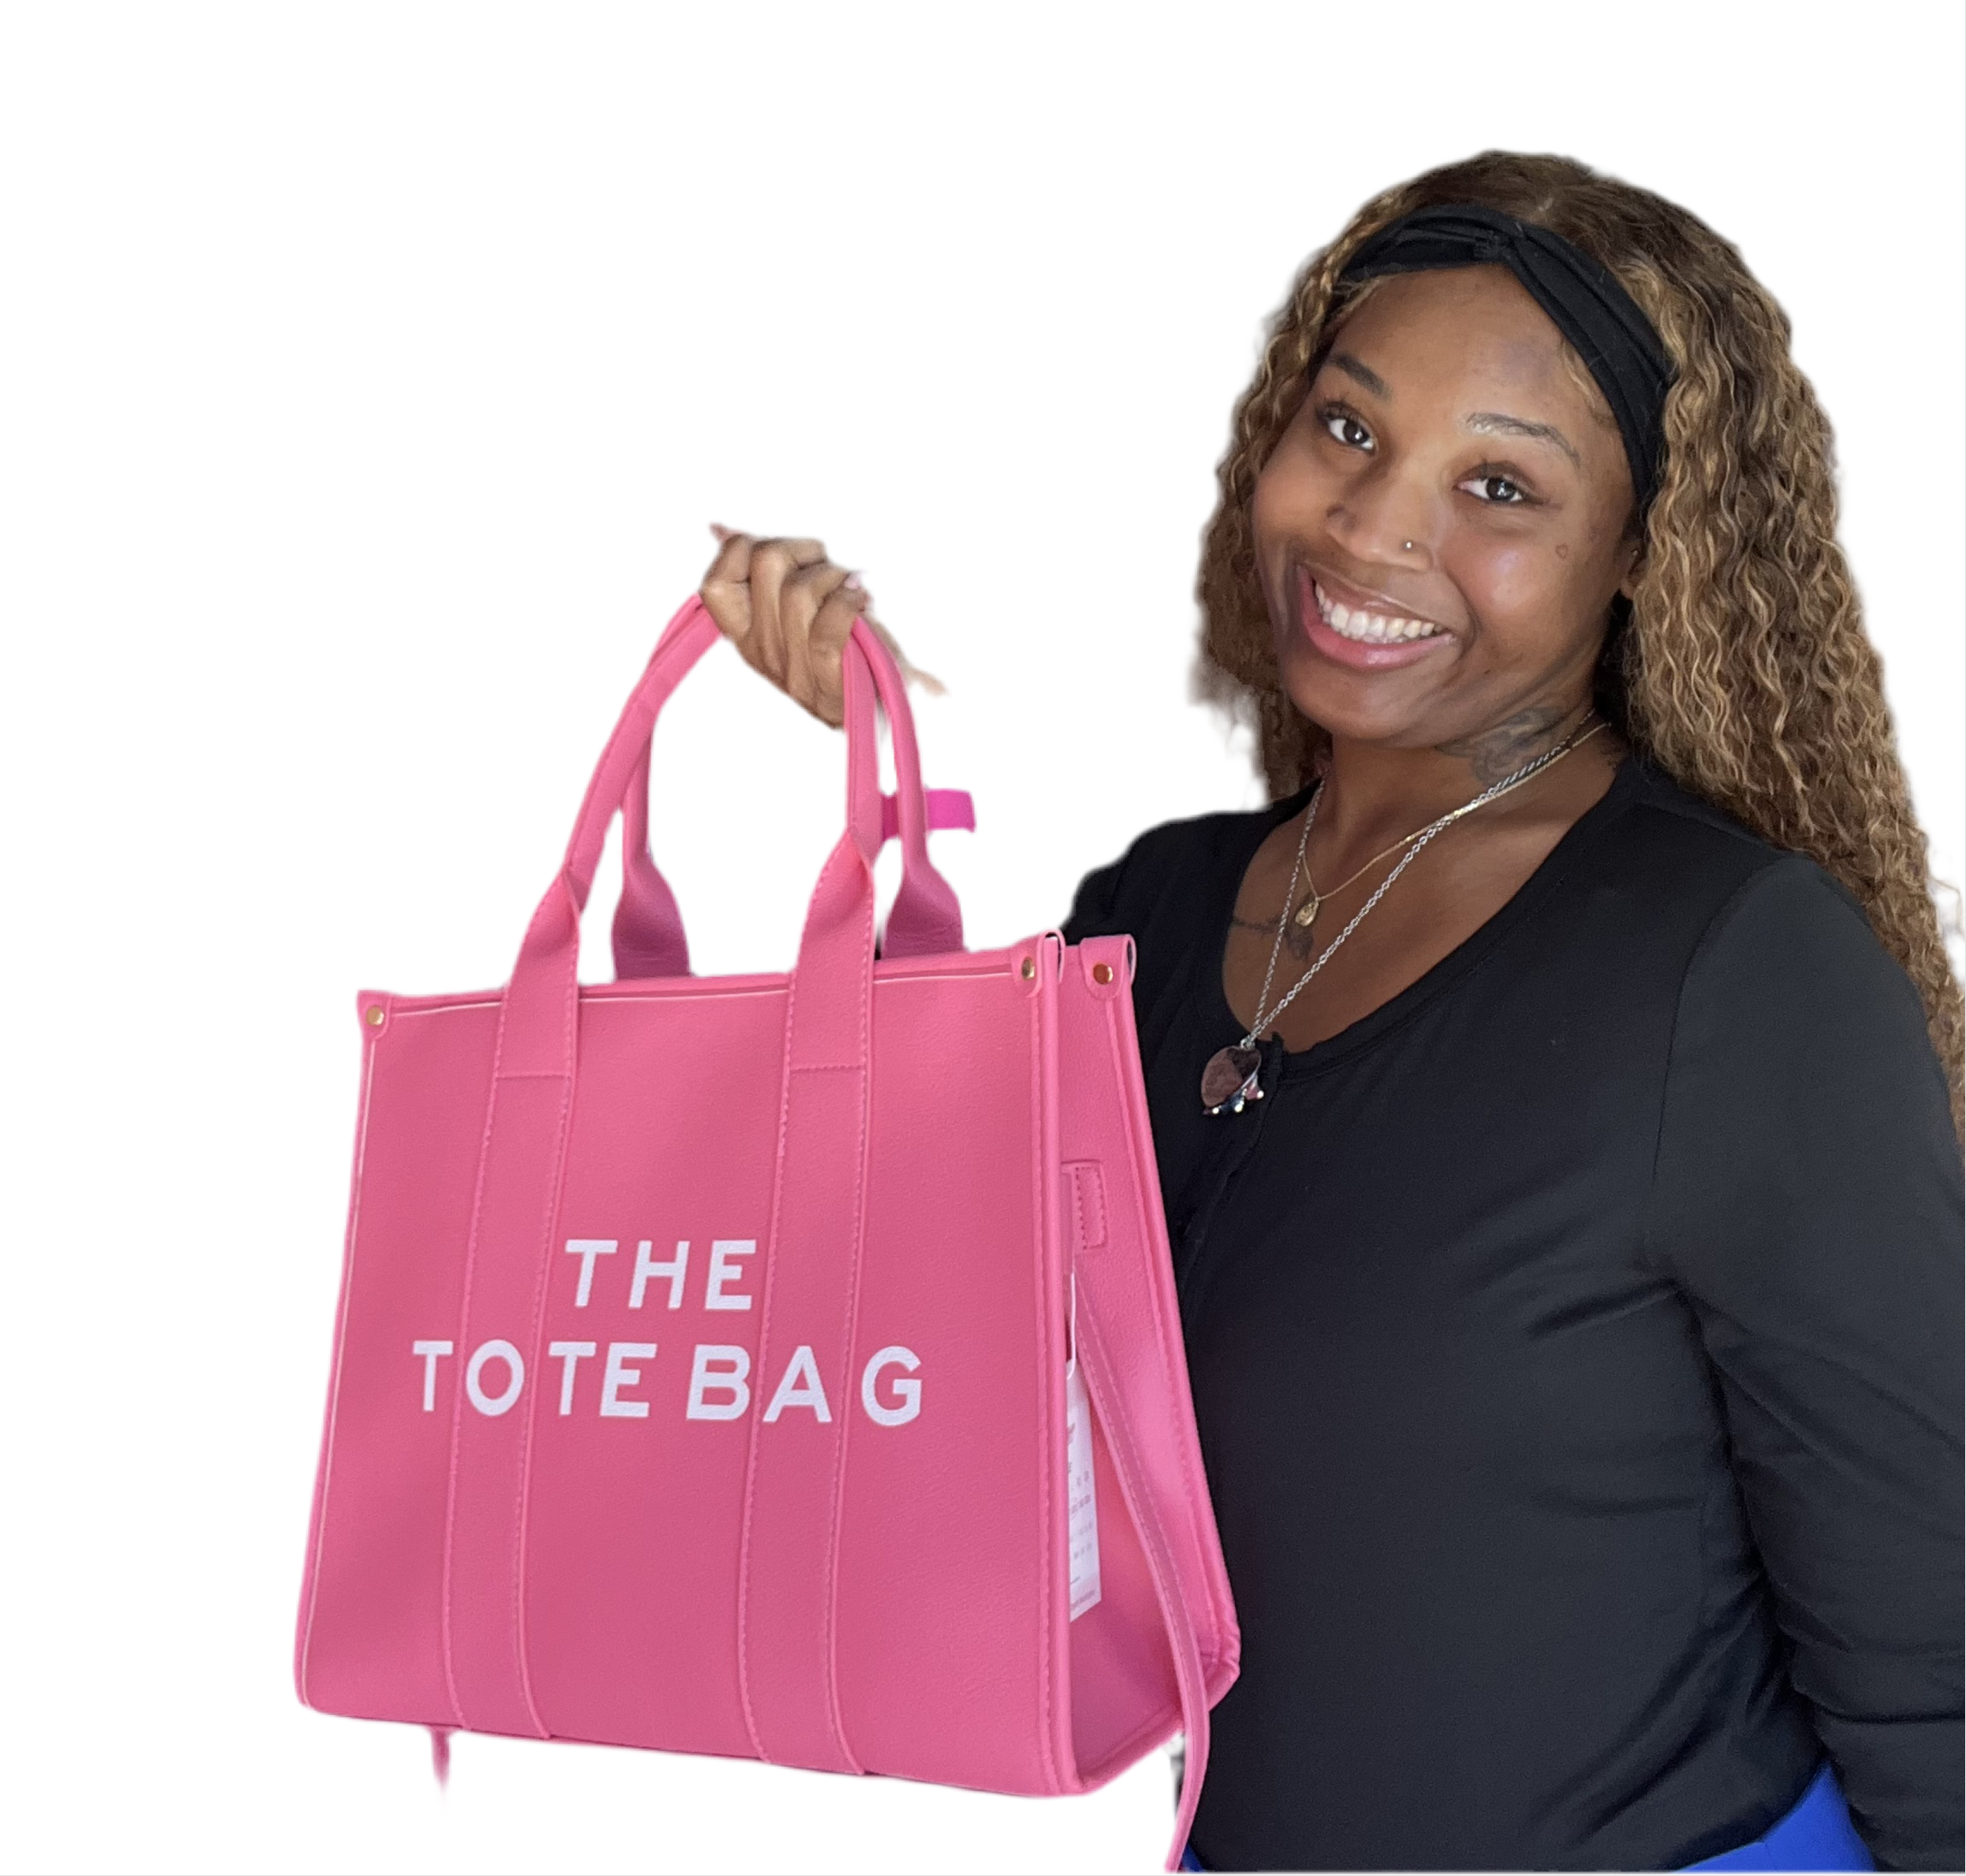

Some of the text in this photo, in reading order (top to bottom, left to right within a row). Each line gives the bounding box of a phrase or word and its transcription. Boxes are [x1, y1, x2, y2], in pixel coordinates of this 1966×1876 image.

[565, 1239, 756, 1310] THE
[413, 1339, 922, 1426] TOTE BAG
